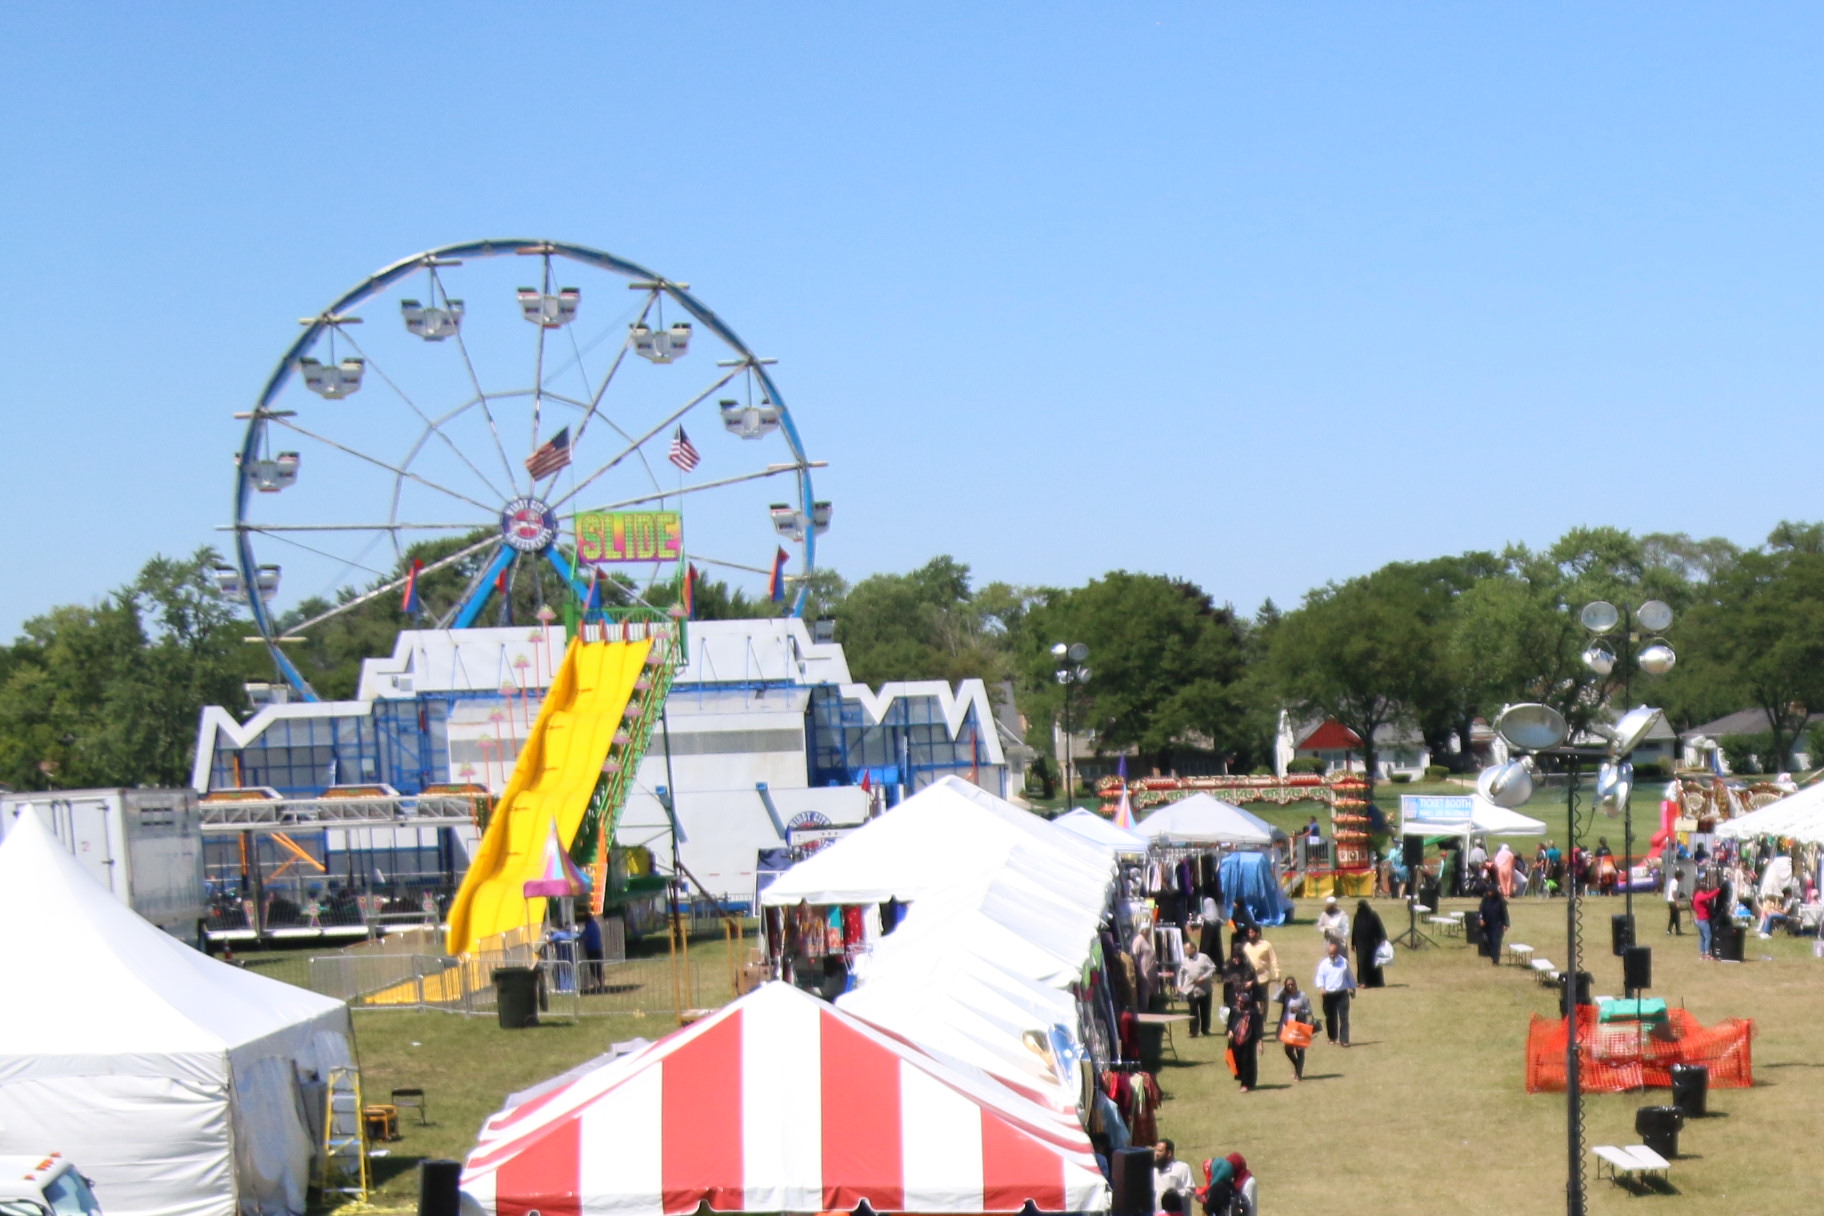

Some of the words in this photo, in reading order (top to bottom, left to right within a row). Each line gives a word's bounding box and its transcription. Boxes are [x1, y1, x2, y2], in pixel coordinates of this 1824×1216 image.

[581, 512, 676, 560] SLIDE
[1420, 799, 1444, 808] TICKET
[1445, 799, 1471, 809] BOOTH
